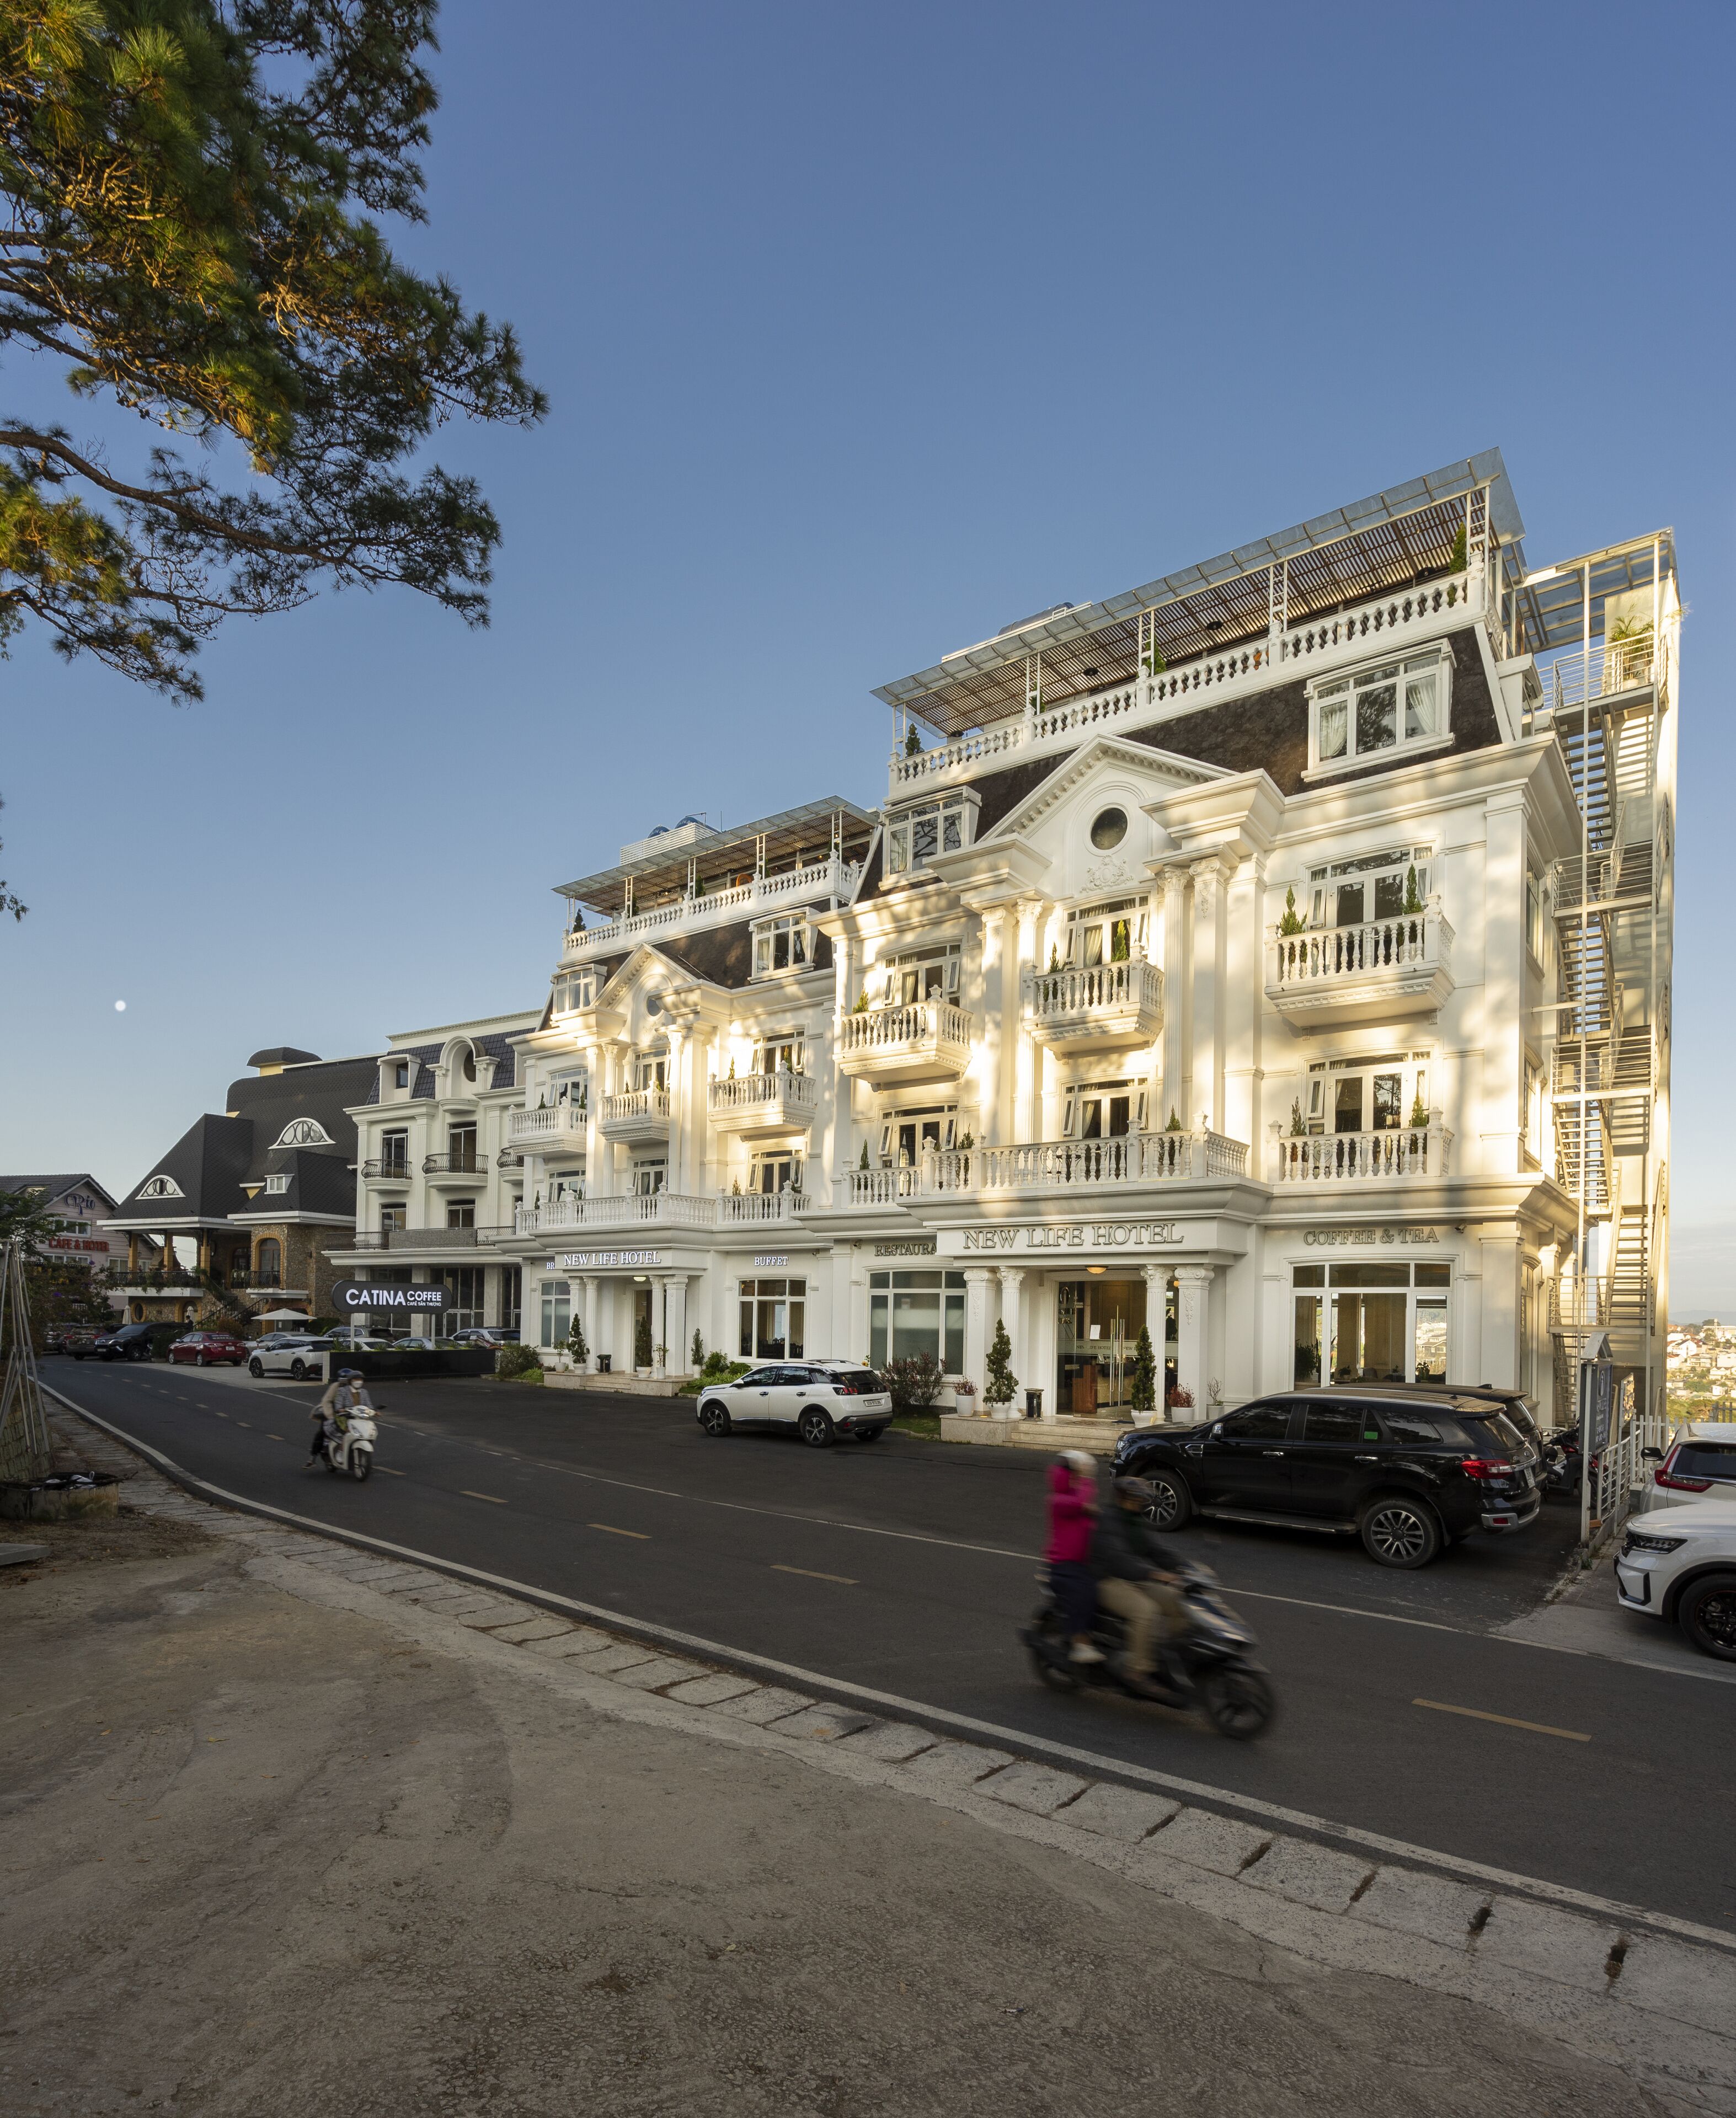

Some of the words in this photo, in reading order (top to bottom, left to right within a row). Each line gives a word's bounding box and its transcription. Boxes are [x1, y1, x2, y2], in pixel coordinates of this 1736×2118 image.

[64, 1194, 95, 1216] Rio
[74, 1239, 81, 1250] &
[83, 1240, 110, 1251] HOTEL
[963, 1229, 1020, 1249] NEW
[1026, 1226, 1084, 1247] LIFE
[1092, 1223, 1184, 1245] HOTEL
[1304, 1229, 1376, 1245] COFFEE
[1380, 1228, 1395, 1244] &
[1398, 1227, 1439, 1243] TEA
[564, 1253, 589, 1266] NEW
[592, 1253, 617, 1265] LIFE
[620, 1251, 661, 1264] HOTEL
[754, 1256, 789, 1266] BUFFET
[345, 1288, 406, 1306] CATINA
[407, 1291, 442, 1301] COFFEE
